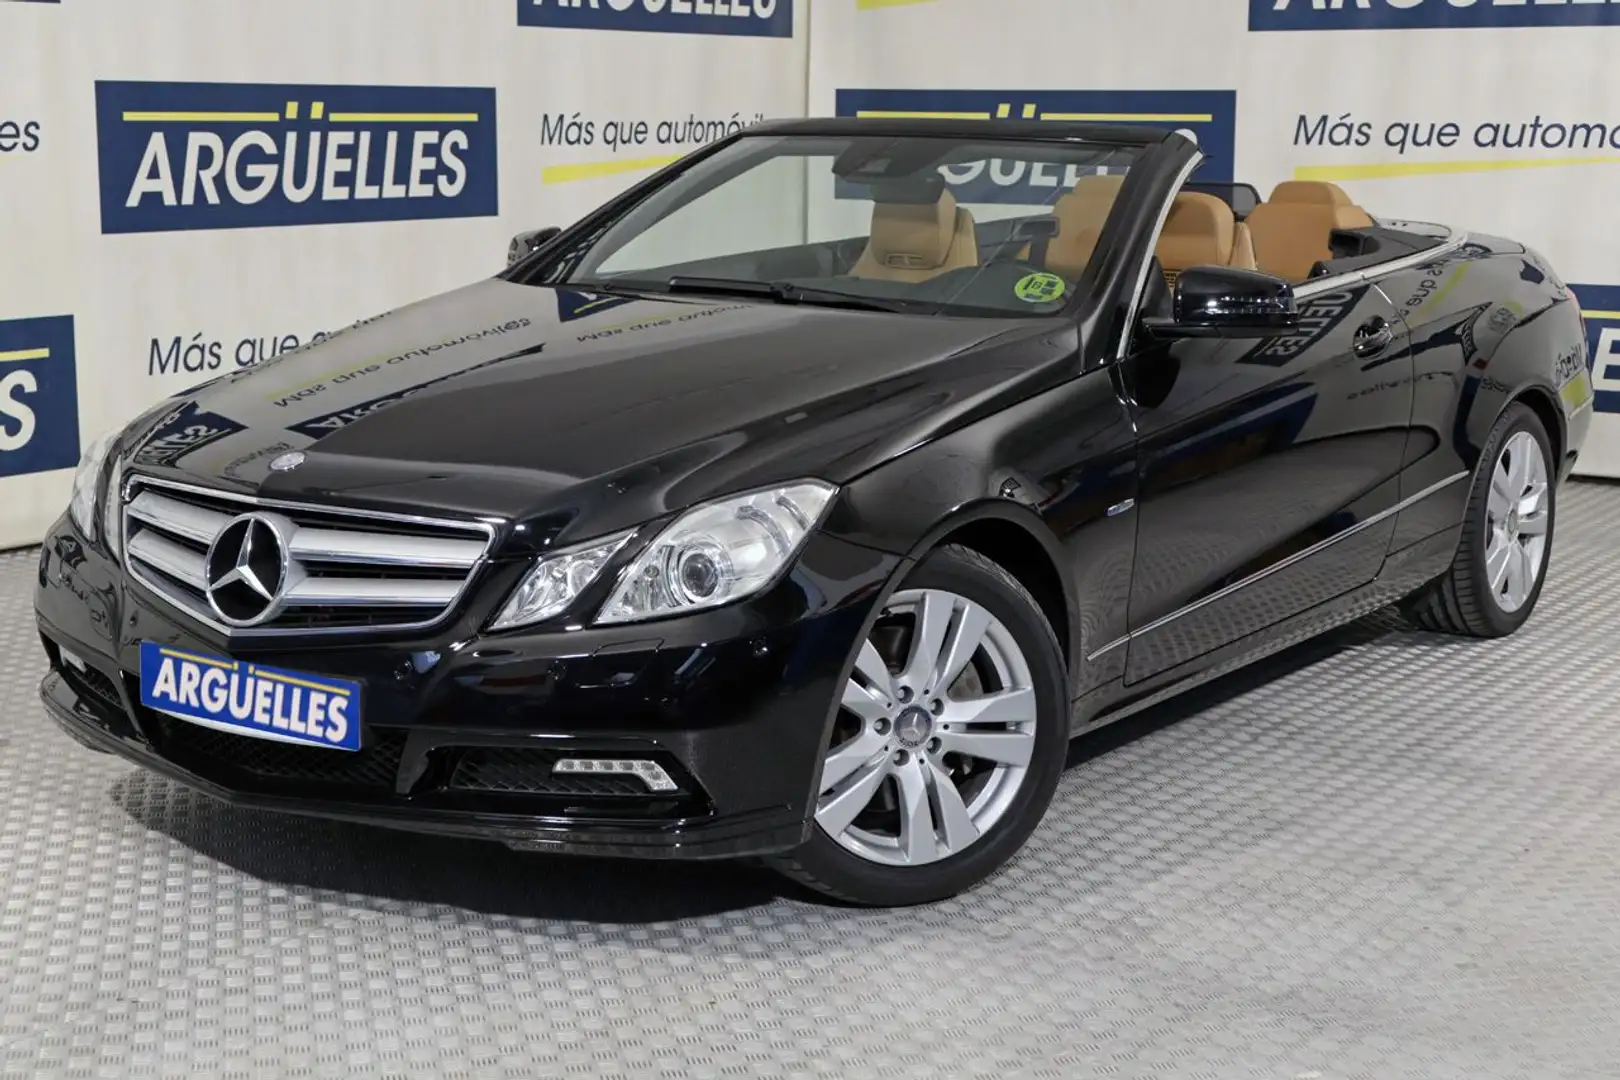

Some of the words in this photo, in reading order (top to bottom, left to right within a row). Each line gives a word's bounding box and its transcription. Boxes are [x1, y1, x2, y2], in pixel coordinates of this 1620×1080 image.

[125, 101, 469, 207] ARGÜELLES
[541, 112, 594, 146] Más
[603, 118, 648, 152] que
[1293, 113, 1372, 146] Más
[1384, 121, 1460, 154] que
[149, 332, 221, 376] Más
[152, 658, 349, 743] ARGÜELLES
